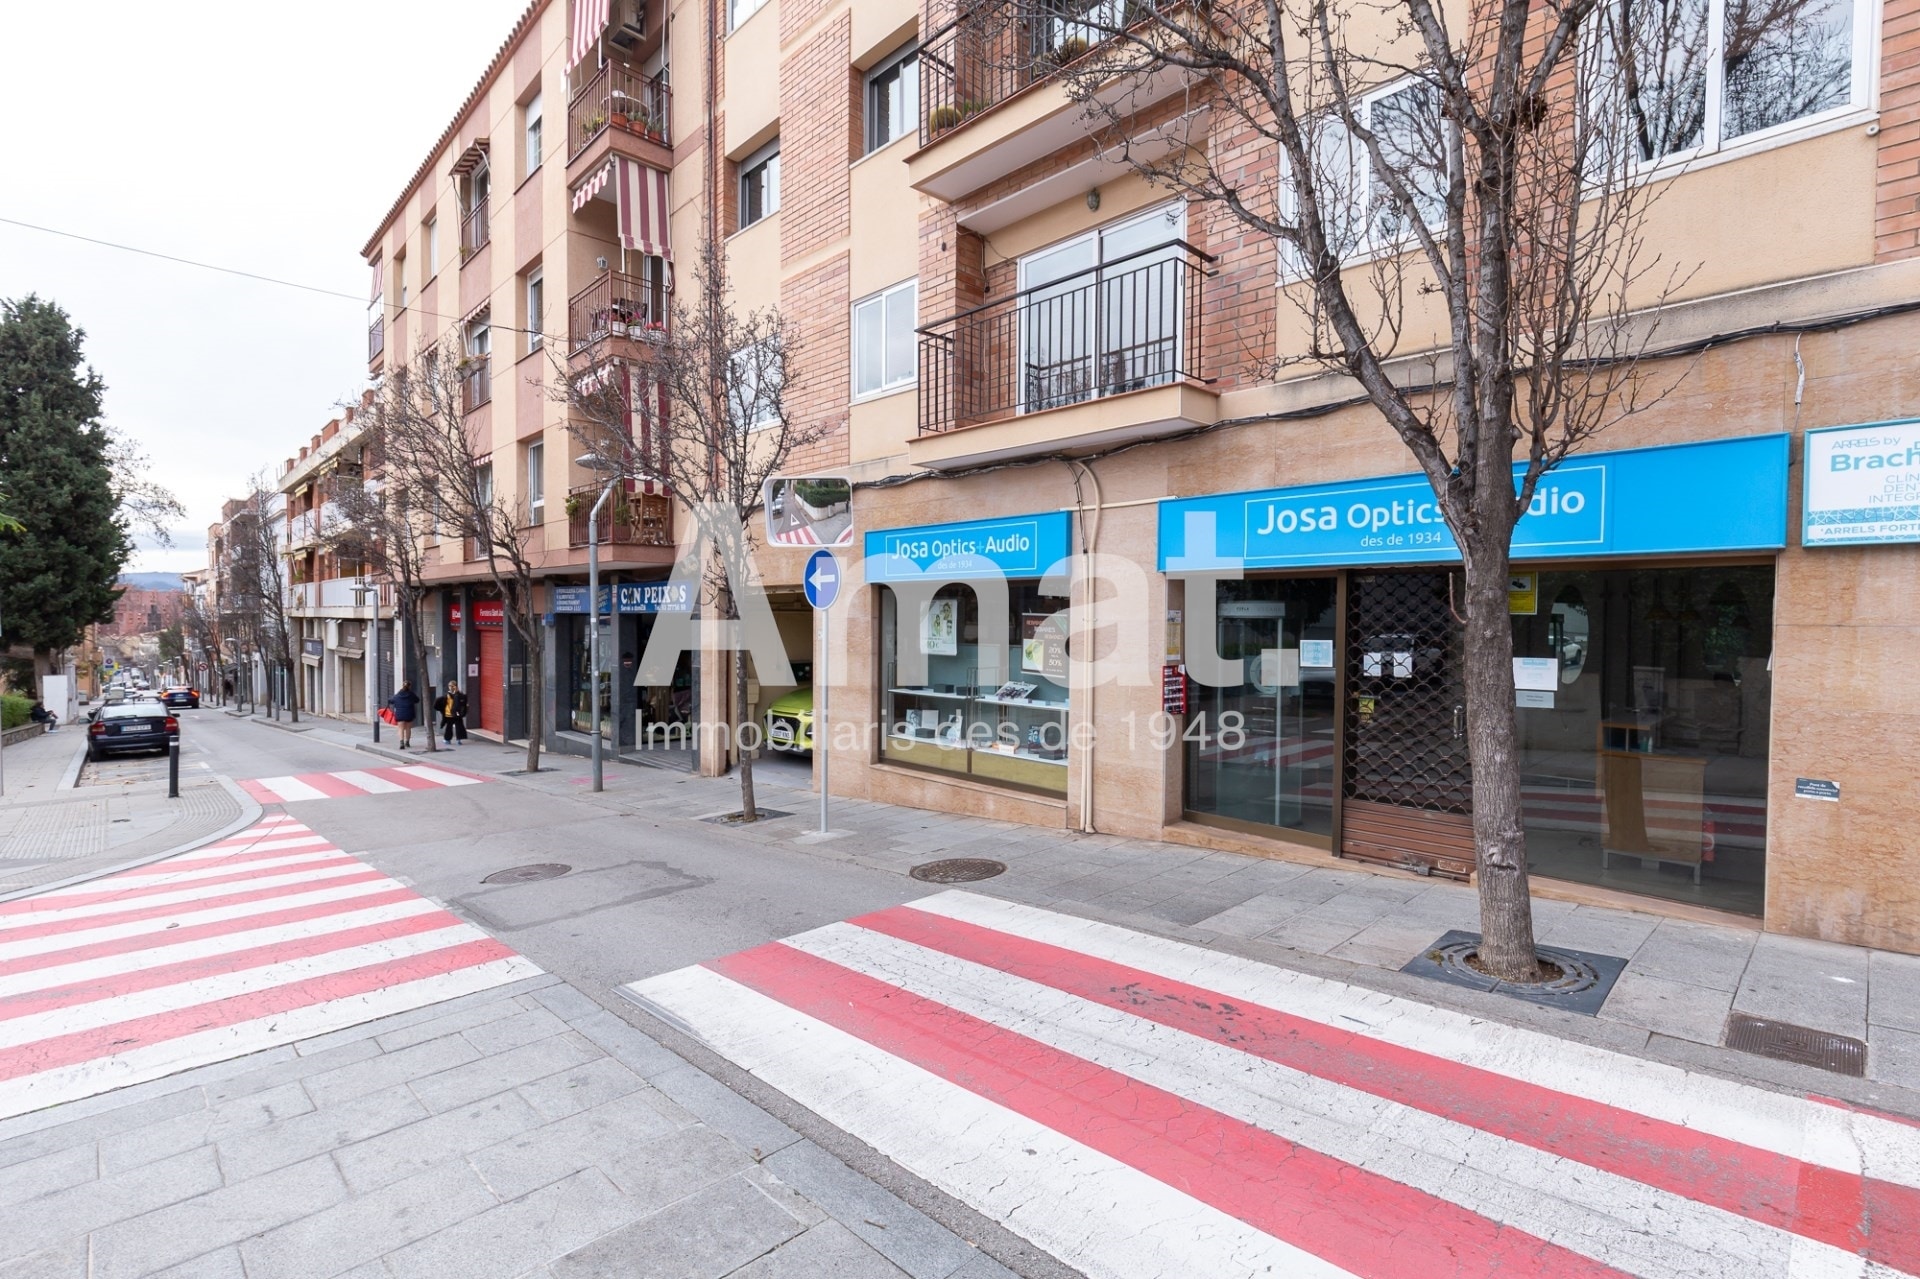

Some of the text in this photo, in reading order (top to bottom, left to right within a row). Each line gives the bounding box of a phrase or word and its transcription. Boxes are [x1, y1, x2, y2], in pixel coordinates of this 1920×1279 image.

[1831, 437, 1881, 450] ARRELS
[1883, 436, 1901, 446] by
[1884, 483, 1920, 493] DEN
[1257, 486, 1586, 535] Josa Optics dio
[891, 539, 929, 560] Josa
[932, 538, 976, 560] Optics
[985, 533, 1030, 554] Audio
[1360, 531, 1442, 547] des de 1934
[937, 559, 972, 570] des de 1934
